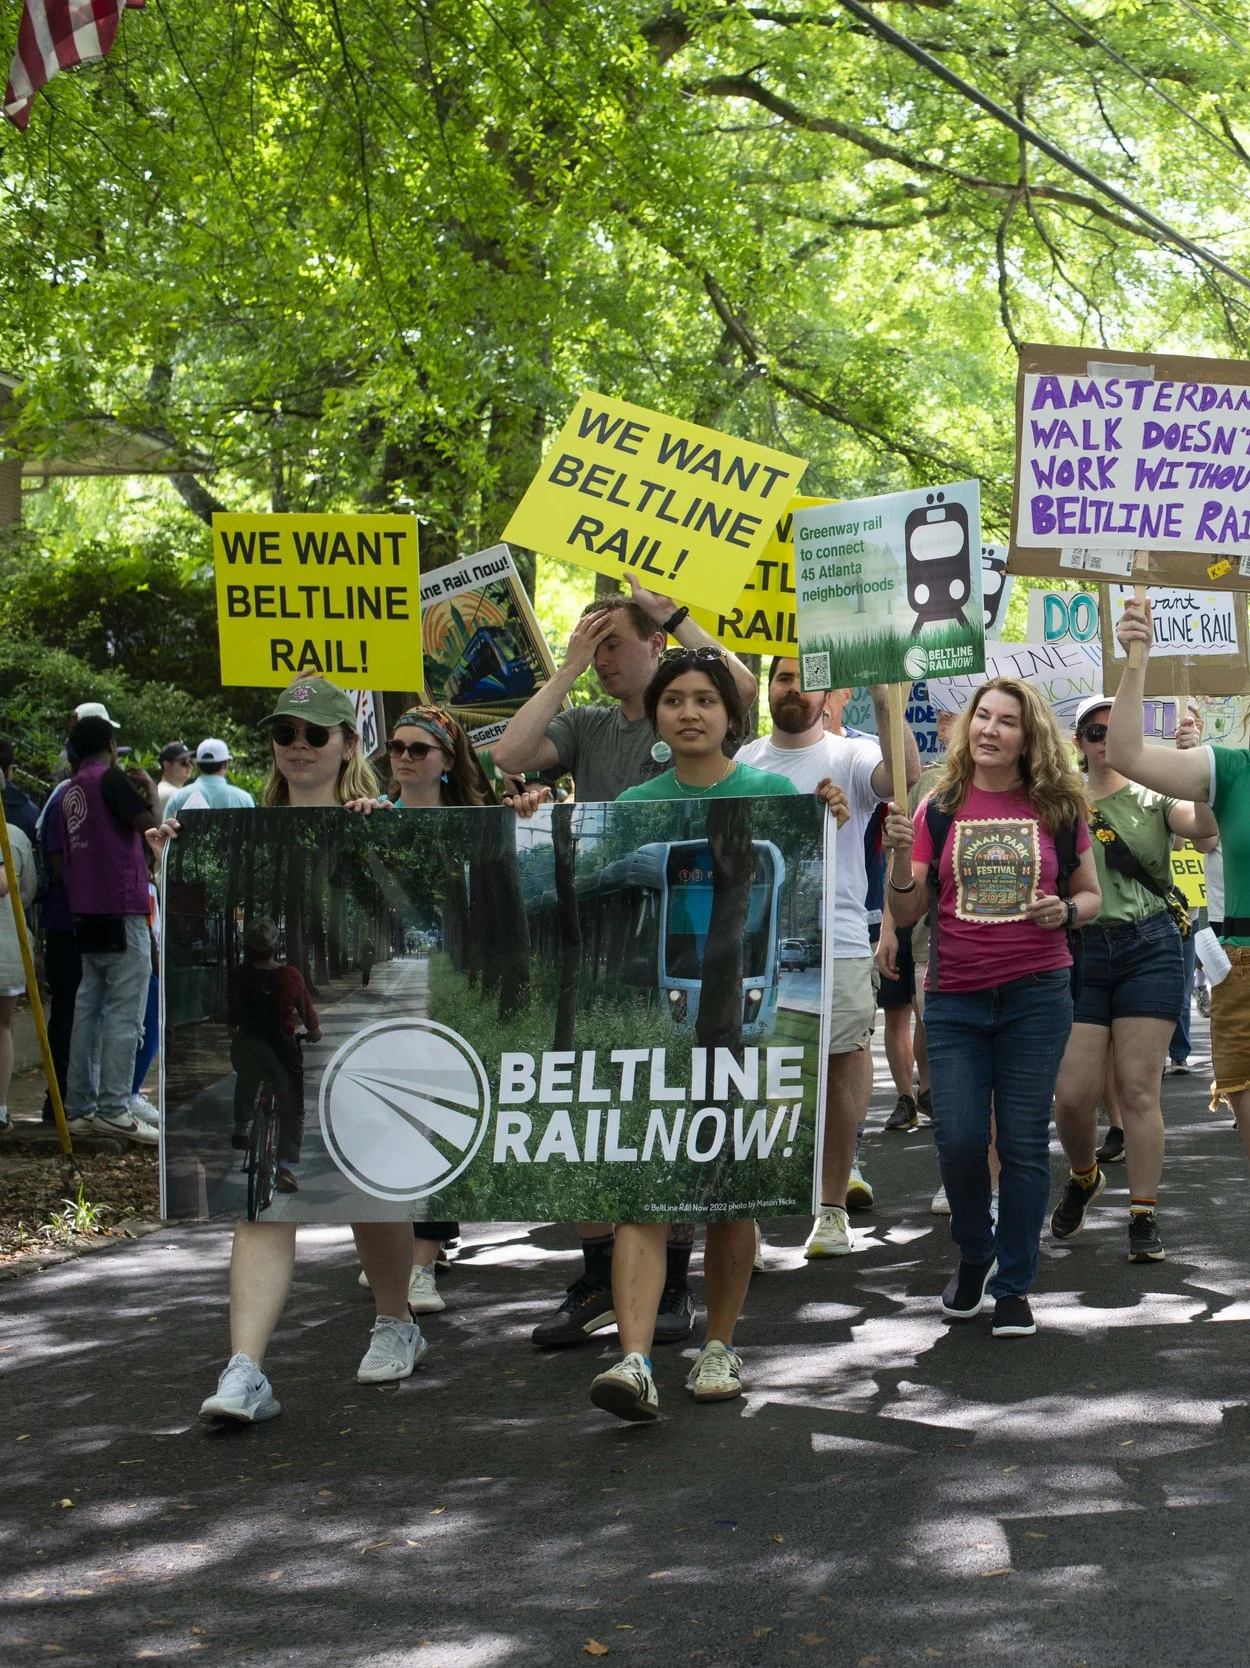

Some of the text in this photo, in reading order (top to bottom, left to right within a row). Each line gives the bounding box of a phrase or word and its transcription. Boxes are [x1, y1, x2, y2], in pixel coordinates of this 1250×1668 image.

[1031, 417, 1123, 451] WALK
[577, 407, 790, 499] WE WANT
[1031, 455, 1119, 491] WORK
[547, 453, 763, 549] BELTLINE
[1031, 494, 1184, 538] BELTLINE
[800, 522, 859, 541] Greenway
[863, 516, 883, 532] rail
[221, 531, 407, 566] WE WANT
[566, 514, 690, 581] RAIL!
[800, 540, 865, 562] to connect
[442, 569, 472, 592] Rail
[801, 561, 862, 582] 45 Atlanta
[226, 584, 410, 620] BELTLINE
[802, 577, 894, 602] neighborhoods
[1200, 612, 1236, 644] RAIL
[270, 638, 369, 674] RAIL!
[928, 646, 973, 660] BELTLINE
[963, 834, 1030, 859] INMAN PARK
[976, 865, 1017, 876] FESTIVAL
[498, 1046, 804, 1104] BELTLINE
[651, 1203, 678, 1212] BeltLine
[679, 1202, 691, 1212] Rail
[692, 1203, 708, 1212] Now
[709, 1203, 728, 1211] 2022
[728, 1202, 747, 1212] photo
[748, 1200, 756, 1210] by
[757, 1199, 778, 1207] Mason
[779, 1197, 796, 1206] Hicks
